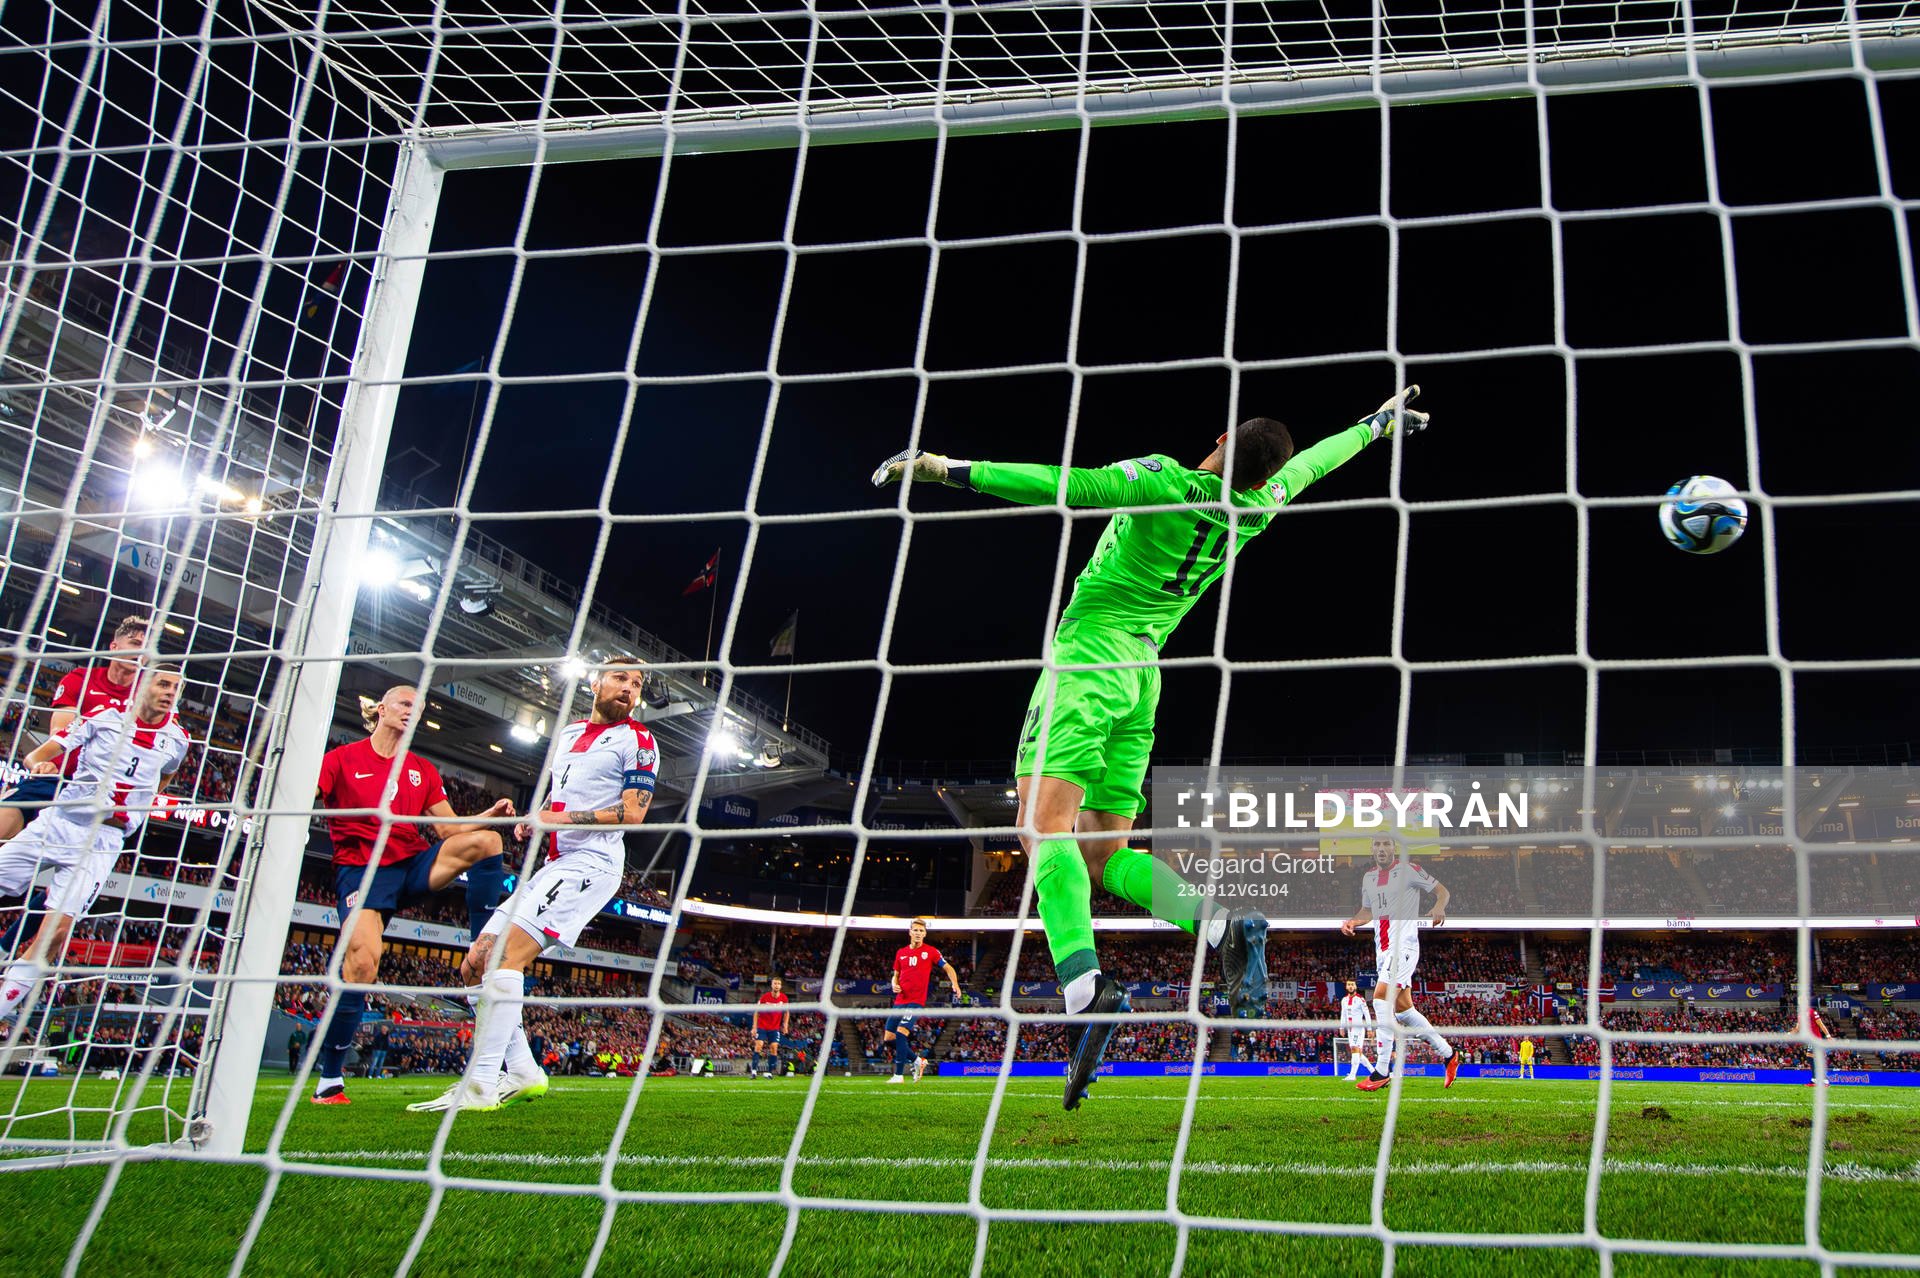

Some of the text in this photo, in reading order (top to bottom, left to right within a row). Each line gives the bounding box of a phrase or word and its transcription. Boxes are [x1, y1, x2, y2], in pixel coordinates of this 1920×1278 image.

[144, 551, 198, 585] teeor
[456, 684, 487, 708] telenor
[1019, 705, 1040, 745] 12
[125, 757, 140, 778] 3
[560, 763, 571, 790] 4
[174, 801, 206, 825] NOR
[775, 814, 799, 825] ama
[1759, 823, 1787, 835] bam
[545, 878, 564, 905] 4
[1377, 892, 1388, 909] 14
[908, 956, 918, 966] 10
[1637, 984, 1655, 995] Bendit
[1674, 984, 1693, 995] Bendit
[1712, 984, 1731, 995] Bendit
[1751, 987, 1764, 995] Ben
[1886, 984, 1906, 995] Bendit
[1267, 1065, 1320, 1075] postnord
[1700, 1071, 1755, 1081] postnord
